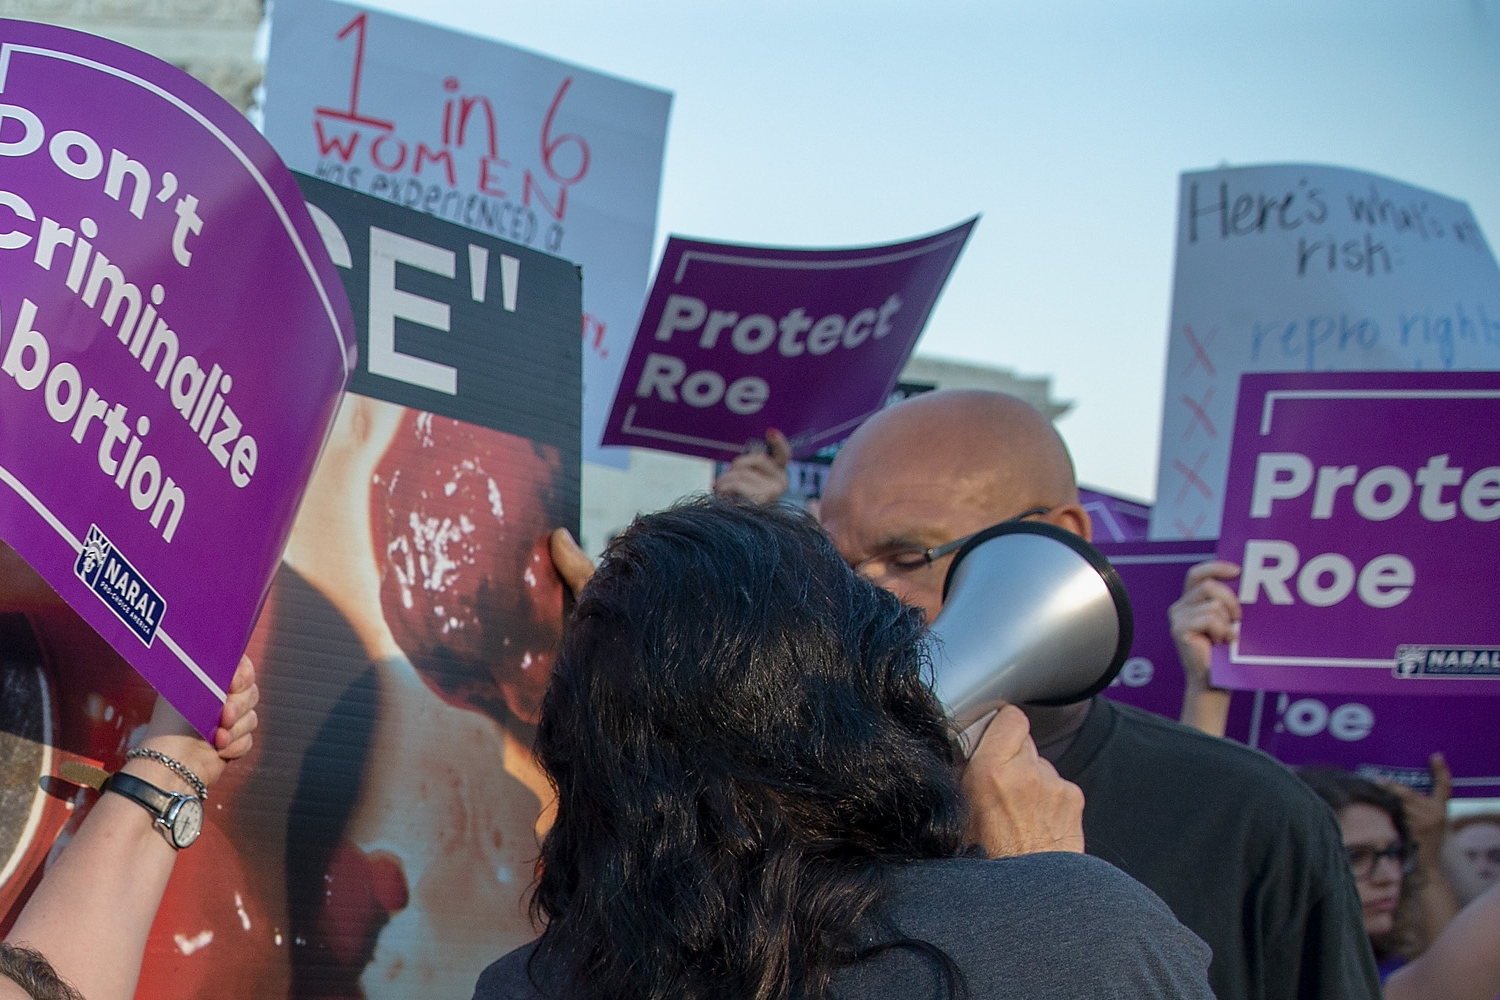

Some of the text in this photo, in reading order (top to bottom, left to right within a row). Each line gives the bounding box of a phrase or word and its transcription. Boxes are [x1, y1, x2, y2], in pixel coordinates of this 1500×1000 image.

[314, 12, 592, 188] 1 in 6
[313, 119, 567, 222] WOMEN
[655, 293, 902, 358] Protect
[636, 352, 771, 416] Roe
[103, 556, 157, 627] NARAL
[1238, 538, 1417, 609] Roe
[1274, 689, 1376, 743] oe
